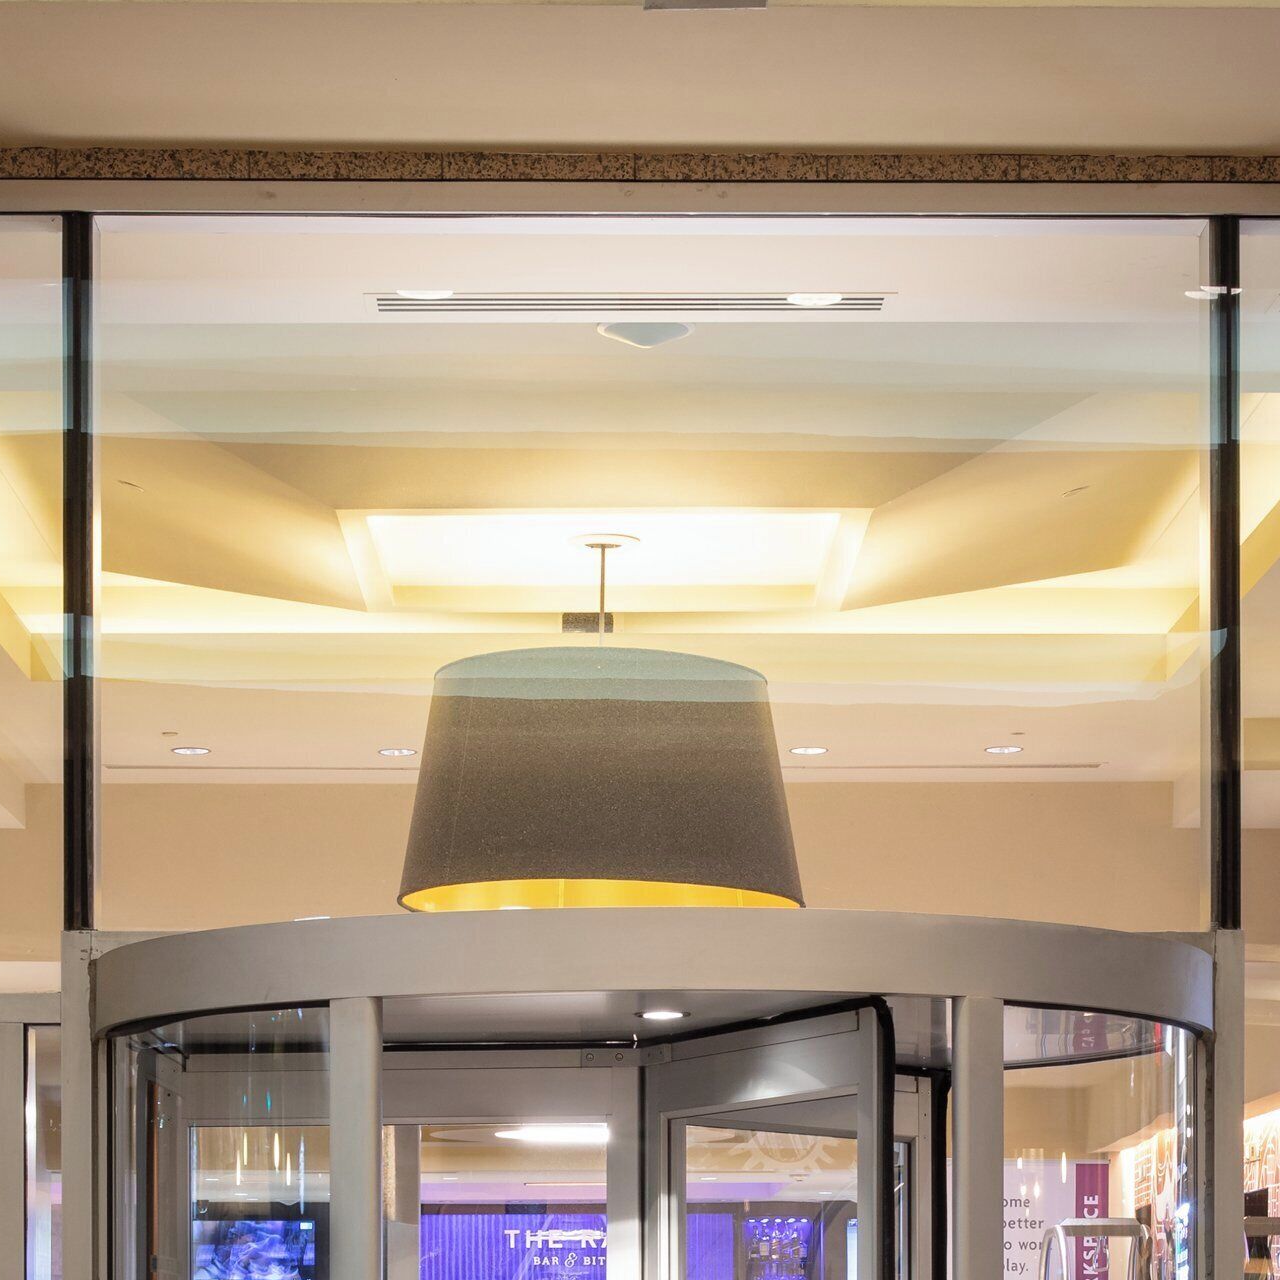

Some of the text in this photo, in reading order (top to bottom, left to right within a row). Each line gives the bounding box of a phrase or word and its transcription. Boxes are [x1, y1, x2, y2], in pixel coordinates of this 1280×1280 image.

[504, 1229, 563, 1249] THE
[1019, 1241, 1044, 1250] wor
[533, 1256, 559, 1266] BAR
[564, 1252, 578, 1268] &
[1003, 1258, 1029, 1275] lay.
